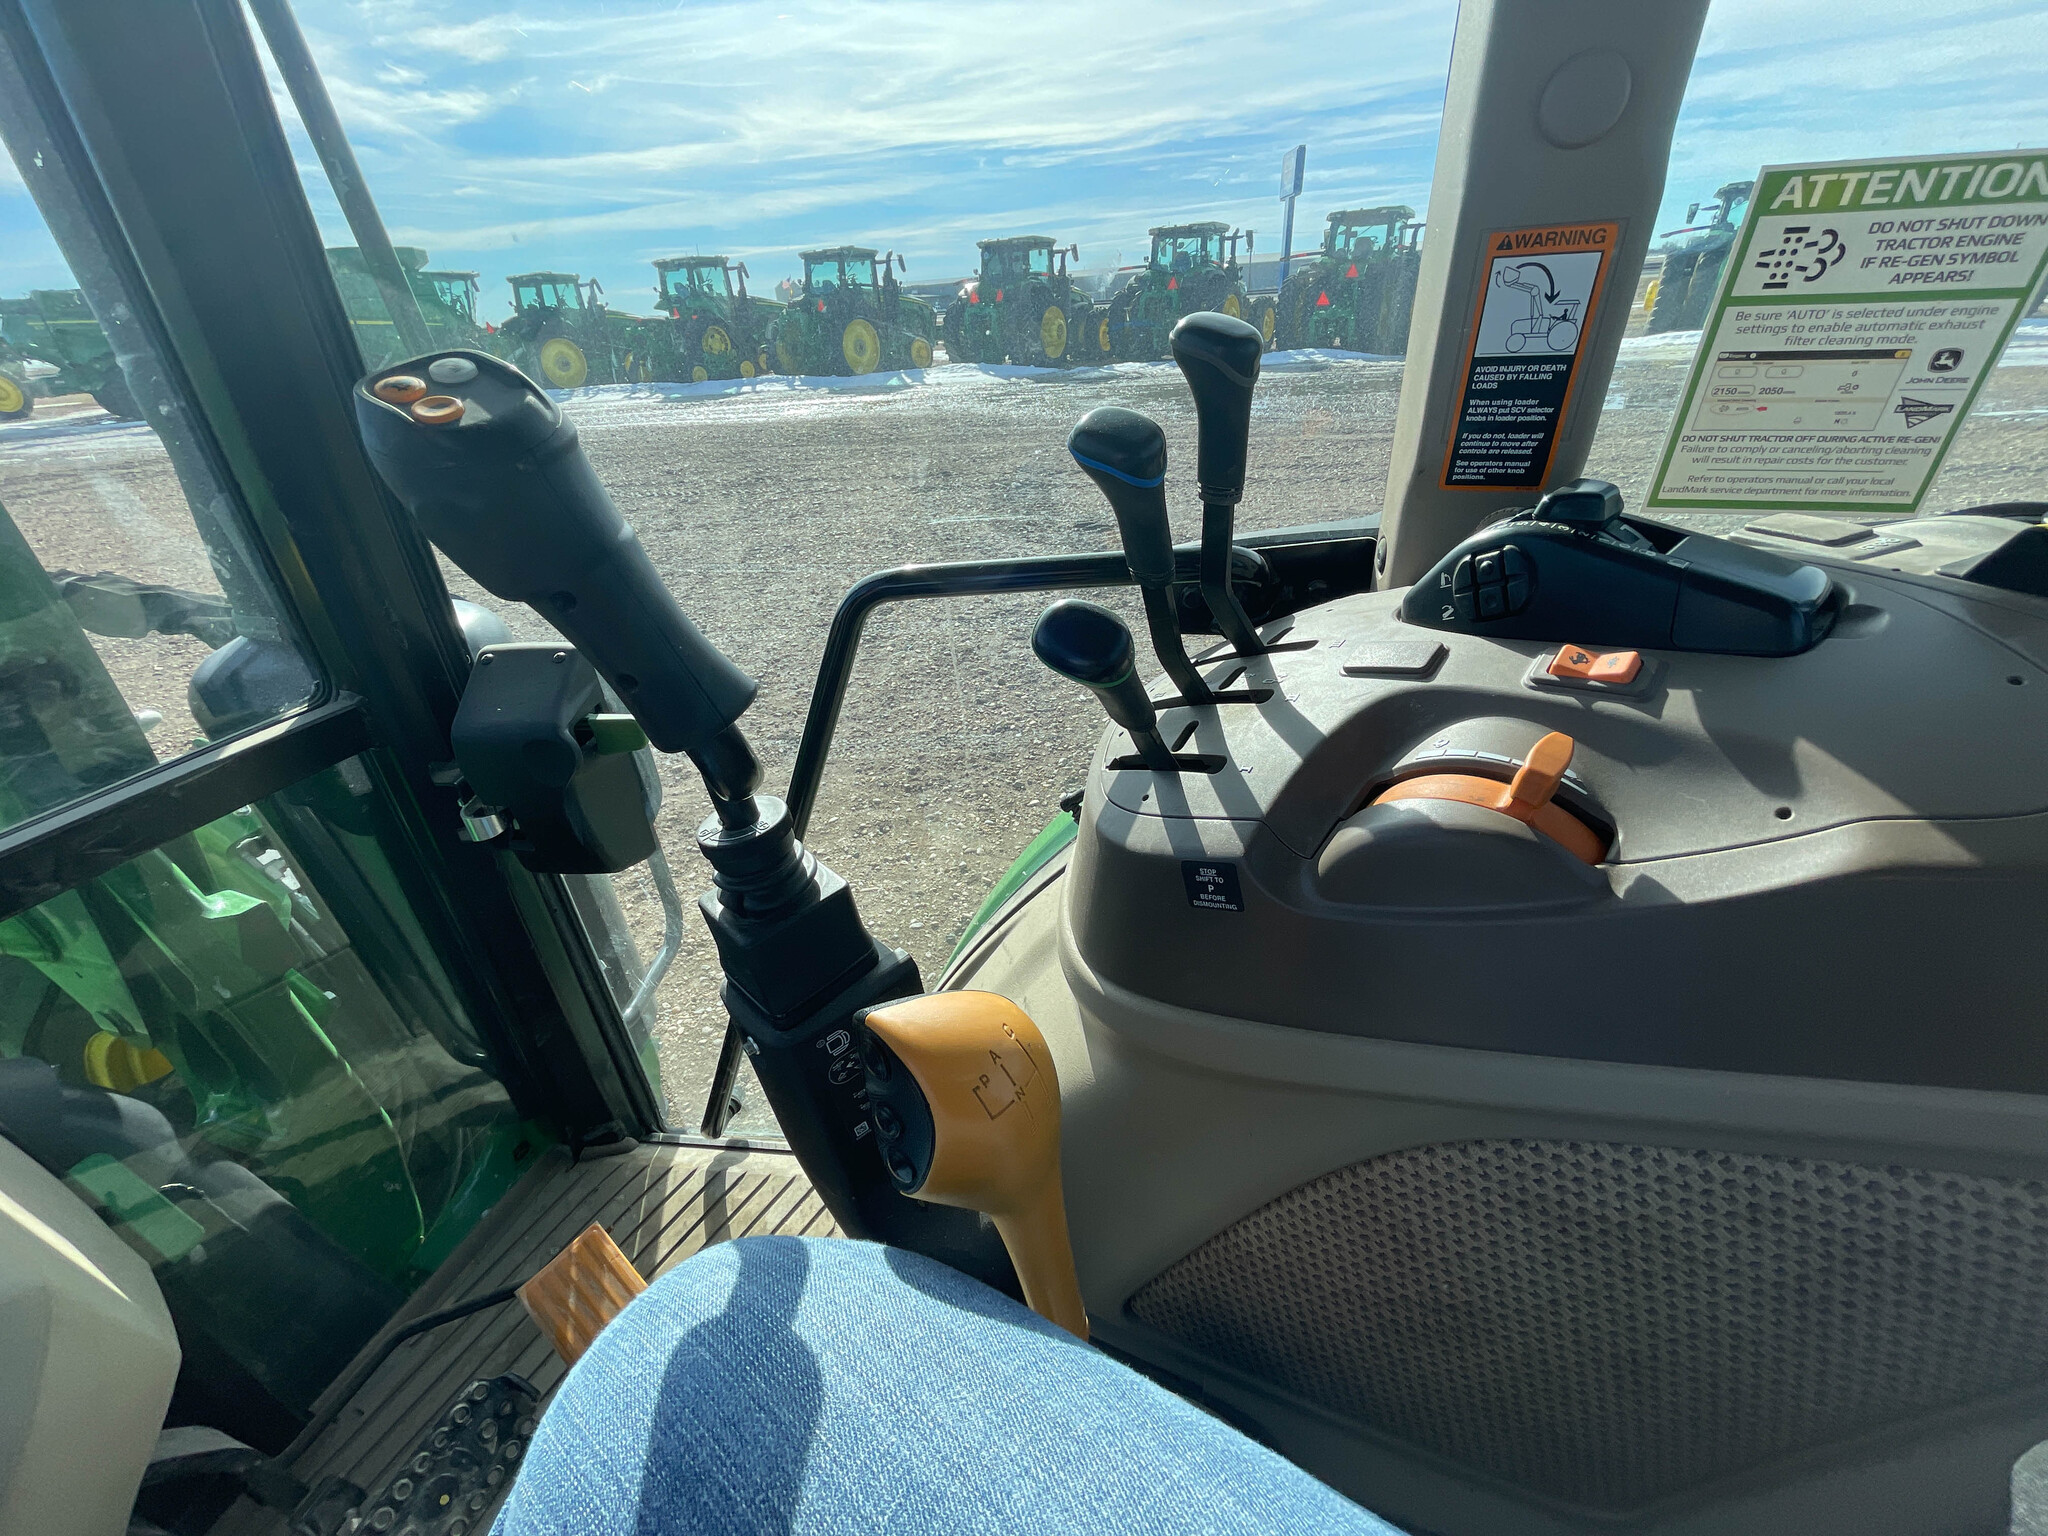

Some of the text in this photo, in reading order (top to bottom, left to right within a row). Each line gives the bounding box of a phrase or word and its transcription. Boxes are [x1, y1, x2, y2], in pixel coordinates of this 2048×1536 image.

[1868, 214, 2048, 234] DO NOT SHUT DOWN
[1516, 228, 1607, 248] WARNING
[1876, 232, 2026, 251] TRACTOR ENGINE
[1860, 250, 2020, 268] IF RE-GEN SYMBOL
[1888, 269, 1975, 284] APPEARS!
[1735, 311, 1751, 321] Be
[1754, 312, 1782, 321] sure
[1832, 309, 1844, 319] is
[1846, 306, 1906, 319] selected
[1907, 306, 1948, 318] under
[1950, 305, 1999, 318] engine
[1735, 319, 1986, 336] settings to enable automatic exhaust
[1784, 334, 1917, 348] filter cleaning mode.
[1758, 387, 1784, 395] 2050
[1492, 399, 1512, 407] using
[1498, 407, 1510, 415] put
[1681, 445, 1714, 453] Failure
[1730, 445, 1767, 455] comply
[1768, 446, 1781, 454] or
[1782, 445, 1883, 456] canceling/aborting
[1885, 446, 1932, 457] cleaning
[1692, 456, 1710, 464] will
[1711, 456, 1741, 464] result
[1743, 456, 1752, 464] in
[1754, 456, 1784, 466] repair
[1816, 456, 1832, 465] for
[1688, 475, 1714, 483] Refer
[1727, 476, 1773, 484] operators
[1776, 477, 1814, 485] manual
[1846, 478, 1868, 486] your
[1744, 487, 1802, 496] department
[1804, 487, 1819, 496] for
[1849, 488, 1911, 496] information.
[989, 1050, 1002, 1064] A
[979, 1074, 990, 1088] P
